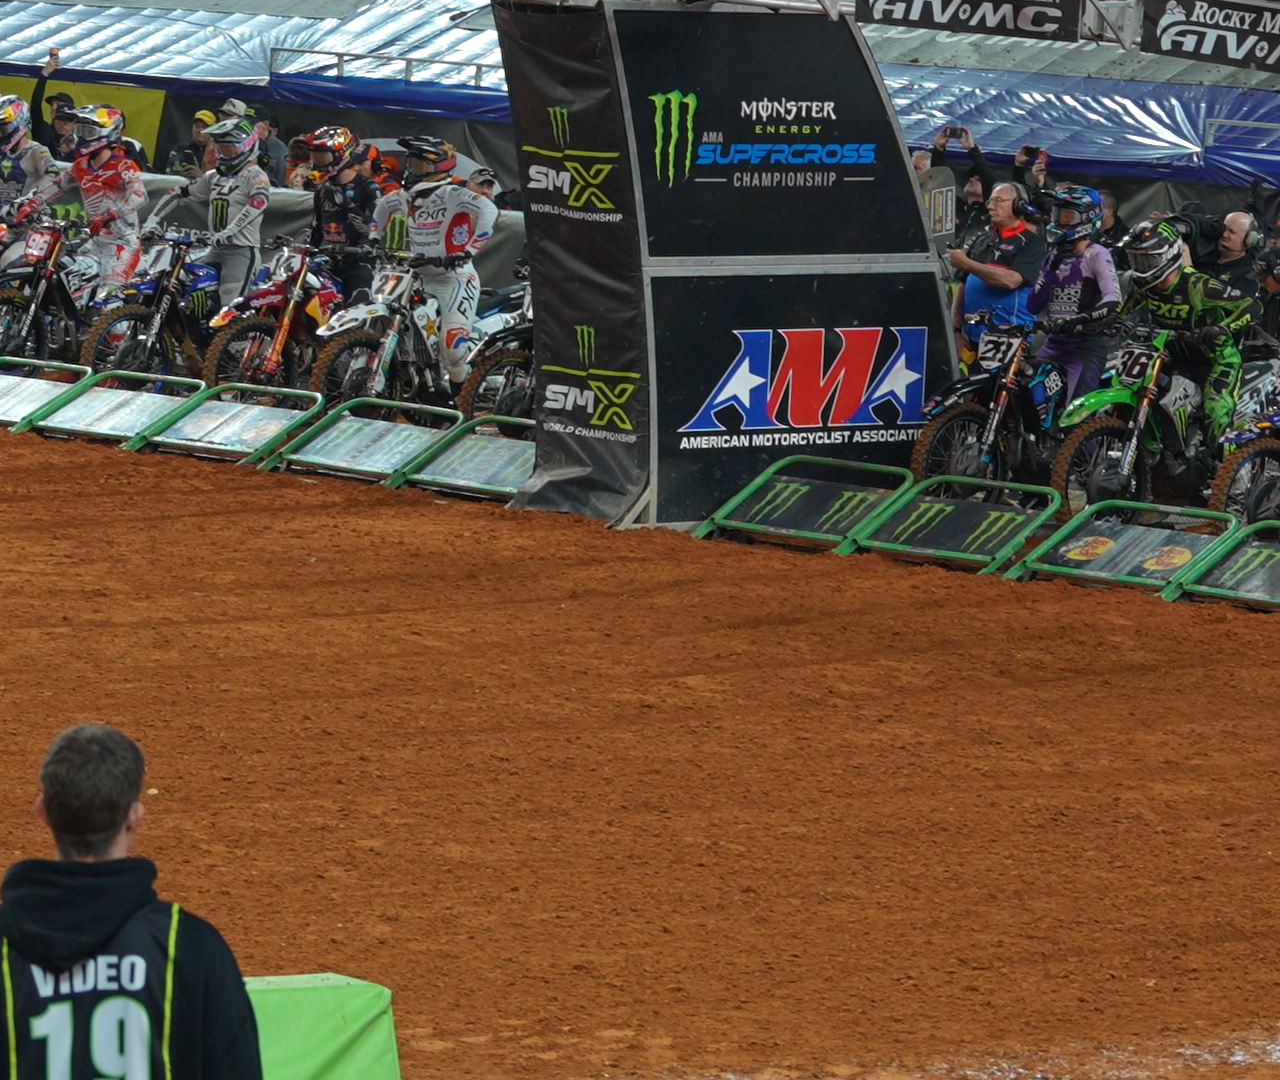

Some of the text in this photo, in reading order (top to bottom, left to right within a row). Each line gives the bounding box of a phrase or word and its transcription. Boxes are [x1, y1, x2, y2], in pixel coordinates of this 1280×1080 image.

[1190, 1, 1255, 32] ROCKY
[740, 96, 837, 121] MONSTER
[702, 131, 724, 144] AMA
[754, 124, 822, 134] ENERGY
[696, 143, 877, 165] SUPERCROSS
[527, 161, 616, 210] SMX
[733, 171, 837, 187] CHAMPIONSHIP
[234, 210, 252, 228] USAF
[417, 208, 447, 220] FXR
[530, 202, 623, 224] WORLD CHAMPIONSHIP
[1082, 209, 1100, 220] FOX
[28, 234, 48, 256] 96
[1148, 301, 1190, 317] FXR
[676, 326, 928, 432] AMA
[1047, 381, 1063, 396] LOCK
[543, 380, 637, 431] SMX
[542, 421, 637, 444] WORLD CHAMPIONSHIP
[679, 435, 750, 450] AMERICAN
[751, 431, 851, 448] MOTORCYCLIST
[30, 954, 146, 998] VIDEO
[29, 995, 152, 1080] 19
